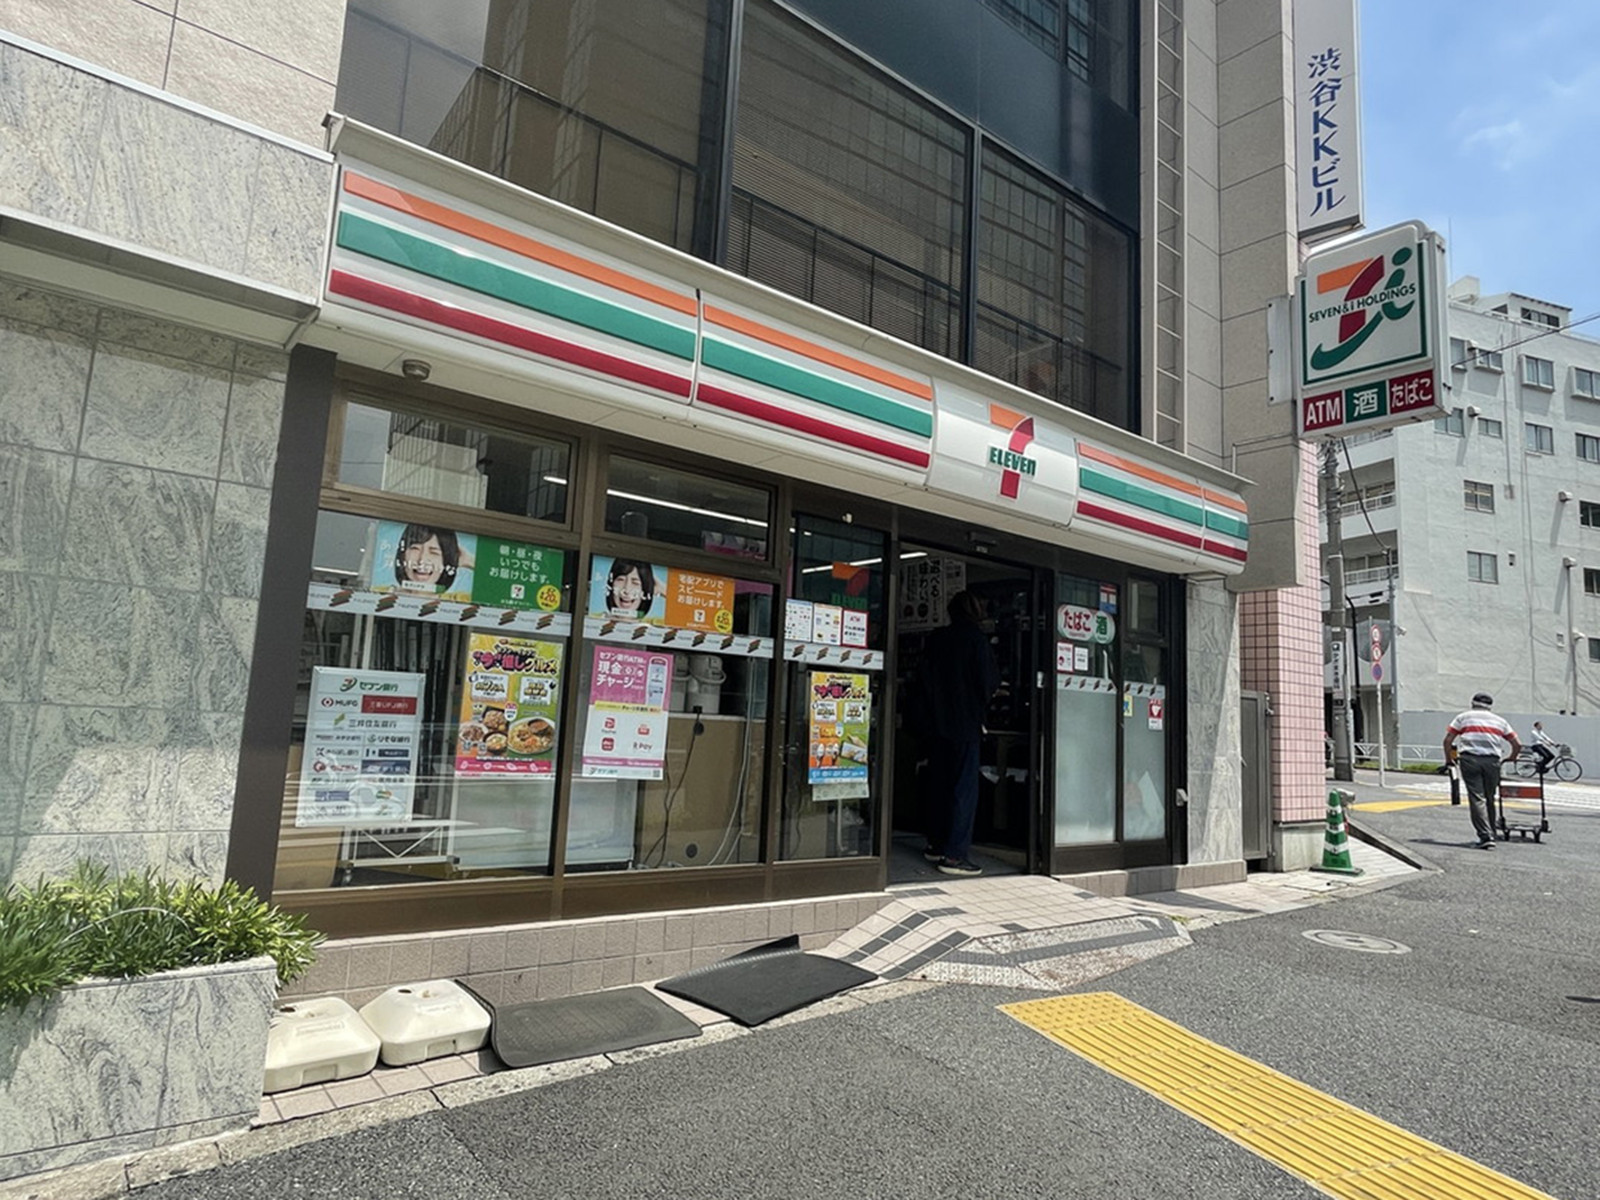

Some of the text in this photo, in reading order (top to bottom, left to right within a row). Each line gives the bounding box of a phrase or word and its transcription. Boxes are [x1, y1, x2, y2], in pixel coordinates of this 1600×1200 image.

[1307, 48, 1346, 217] 渋谷KKビル
[1357, 282, 1416, 309] HOLDINGS
[1306, 378, 1433, 426] ATM 酒 たばこ
[500, 557, 540, 572] いつでも
[1063, 609, 1107, 635] たばこ 酒
[598, 660, 622, 675] 現金
[360, 681, 399, 692] セブン銀行
[596, 674, 635, 688] チャージ
[335, 699, 359, 708] MUFG
